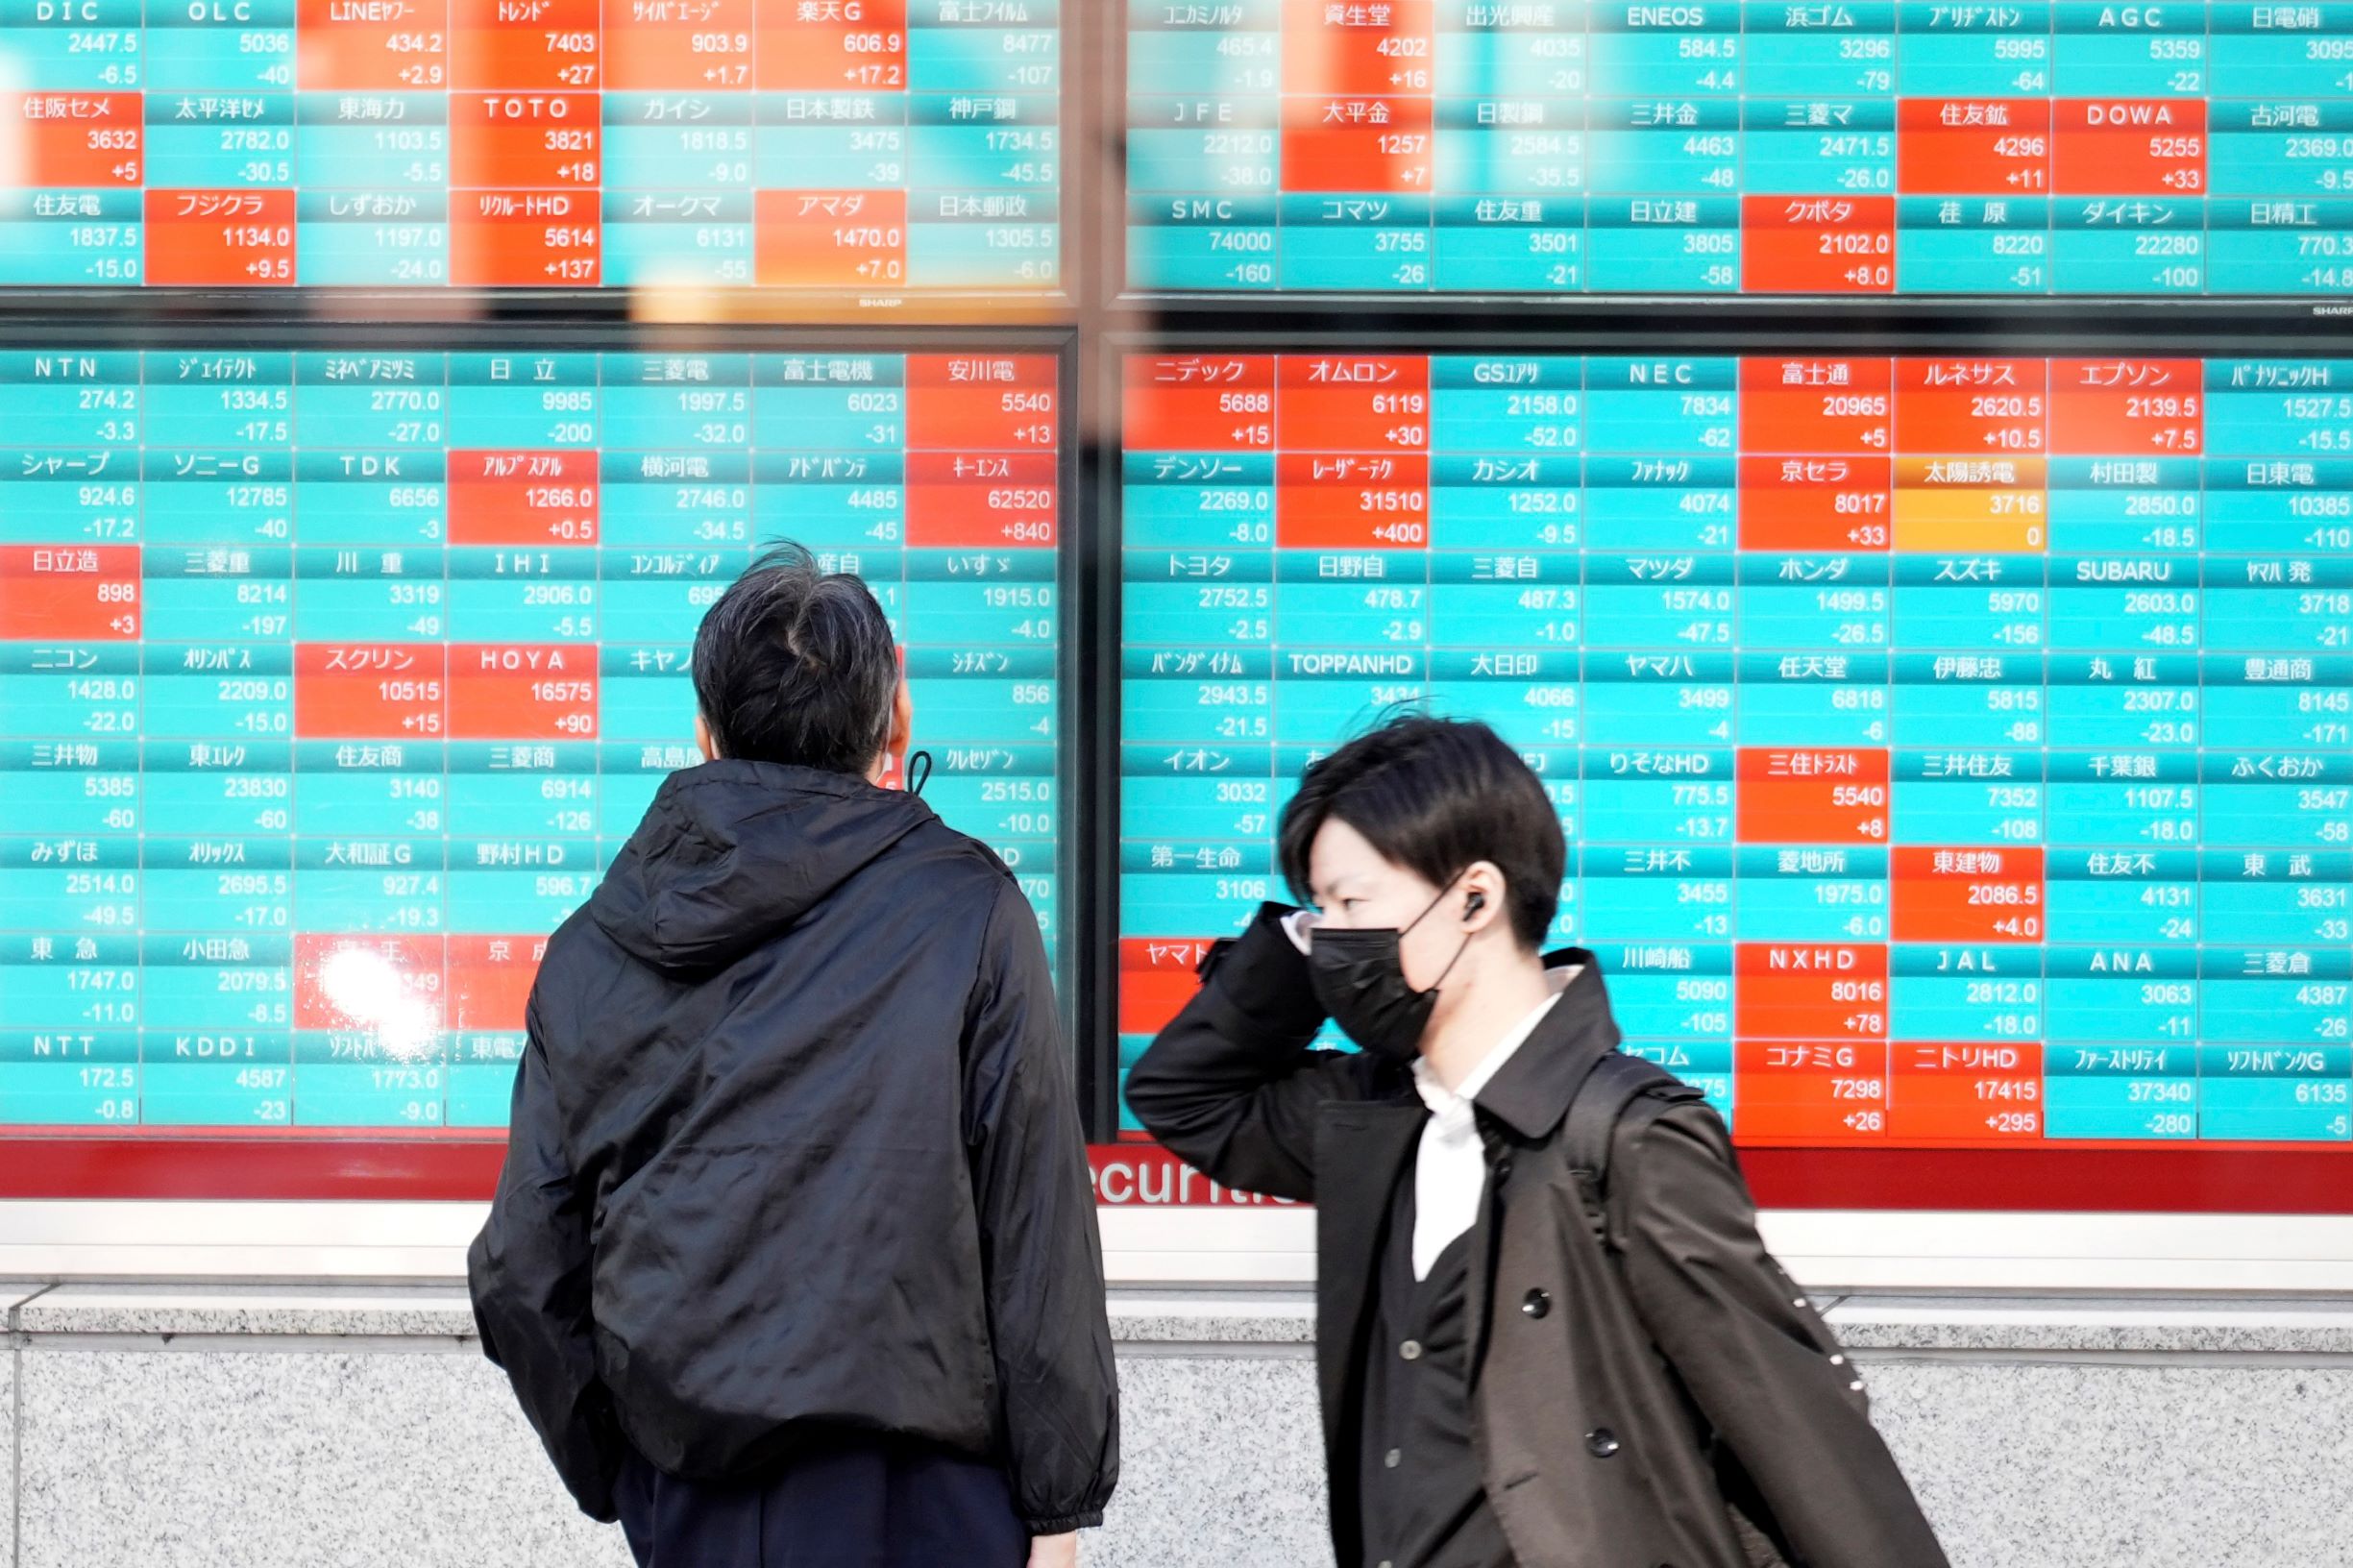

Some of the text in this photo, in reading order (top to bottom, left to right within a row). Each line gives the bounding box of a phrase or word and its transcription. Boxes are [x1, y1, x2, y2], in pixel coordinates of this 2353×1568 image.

[797, 1, 862, 21] 楽天G
[1628, 6, 1703, 27] ENEOS
[844, 33, 902, 53] 606.9
[1679, 37, 1736, 59] 584.5
[845, 64, 900, 86] +17.2
[1696, 70, 1735, 89] -4.4
[22, 97, 111, 118] 住阪セメ
[948, 97, 1017, 119] 神戸鋼
[1323, 101, 1389, 124] 大平金
[1784, 103, 1852, 126] 三菱マ
[1939, 103, 2008, 126] 住友鉱
[87, 130, 137, 150] 3632
[544, 130, 594, 151] 3821
[985, 132, 1052, 152] 1734.5
[1377, 135, 1426, 155] 1257
[1819, 135, 1890, 157] 2471.5
[1993, 136, 2045, 157] 4296
[2149, 137, 2200, 158] 5255
[111, 160, 137, 182] +5
[556, 161, 595, 182] +18
[1000, 163, 1052, 182] -45.5
[1400, 165, 1429, 185] +7
[1836, 167, 1890, 188] -26.0
[2006, 168, 2044, 188] +11
[2161, 169, 2200, 189] +33
[34, 193, 101, 216] 住友電
[178, 194, 263, 216] フジクラ
[1322, 200, 1388, 221] コマツ
[1474, 199, 1541, 222] 住友重
[1630, 199, 1697, 224] 日立建
[1785, 199, 1853, 222] クボタ
[2082, 201, 2173, 224] ダイキン
[70, 226, 138, 247] 1837.5
[222, 227, 290, 247] 1134.0
[1375, 232, 1426, 252] 3755
[1529, 233, 1579, 253] 3501
[1683, 233, 1734, 254] 3805
[1819, 233, 1891, 255] 2102.0
[2135, 234, 2199, 256] 22280
[86, 258, 137, 279] -15.0
[245, 258, 290, 279] +9.5
[1391, 264, 1426, 283] -26
[1546, 264, 1579, 285] -21
[1700, 265, 1734, 285] -58
[1844, 265, 1890, 285] +8.0
[2152, 266, 2199, 286] -100
[859, 299, 902, 307] SHARP
[642, 358, 709, 381] 三菱電
[783, 358, 872, 381] 富士電機
[947, 359, 1016, 381] 安川電
[1156, 360, 1244, 381] ニデック
[1309, 360, 1397, 382] オムロン
[1781, 362, 1849, 385] 富士通
[1924, 363, 2015, 385] ルネサス
[677, 391, 746, 412] 1997.5
[846, 391, 898, 412] 6023
[1001, 393, 1051, 412] 5540
[1219, 393, 1270, 413] 5688
[1372, 394, 1424, 414] 6119
[1822, 396, 1886, 416] 20965
[1971, 396, 2042, 417] 2620.5
[692, 424, 746, 444] -32.0
[865, 424, 896, 445] -31
[1014, 425, 1051, 444] +13
[1231, 425, 1270, 445] +15
[1385, 426, 1424, 446] +30
[1859, 428, 1886, 448] +5
[1982, 429, 2042, 449] +10.5
[22, 452, 111, 476] シャープ
[175, 453, 259, 477] ソニーG
[1156, 456, 1242, 479] デンソー
[1780, 459, 1850, 482] 京セラ
[1924, 460, 2015, 483] 太陽誘電
[79, 486, 135, 506] 924.6
[226, 485, 287, 507] 12785
[988, 489, 1051, 509] 62520
[1198, 491, 1269, 511] 2269.0
[1834, 492, 1888, 514] 8017
[1989, 493, 2042, 515] 3716
[84, 517, 135, 538] -17.2
[255, 518, 288, 539] -40
[1001, 522, 1050, 541] +840
[1229, 521, 1268, 543] -8.0
[1847, 526, 1888, 547] +33
[33, 549, 98, 573] 日立造
[1169, 553, 1232, 576] トヨタ
[1318, 553, 1383, 577] 日野自
[1626, 557, 1693, 579] マツダ
[2076, 560, 2171, 581] SUBARU
[97, 583, 135, 602] 898
[1198, 587, 1268, 608] 2752.5
[1363, 588, 1424, 609] 478.7
[1661, 591, 1730, 611] 1574.0
[2123, 592, 2196, 614] 2603.0
[110, 614, 135, 634] +3
[1228, 619, 1268, 640] -2.5
[1382, 620, 1423, 642] -2.9
[1676, 623, 1730, 643] -47.5
[2142, 624, 2194, 646] -48.5
[31, 649, 98, 670] ニコン
[325, 649, 414, 671] スクリン
[1777, 656, 1847, 678] 任天堂
[1932, 656, 2000, 680] 伊藤忠
[67, 678, 135, 700] 1428.0
[379, 681, 441, 701] 10515
[530, 681, 593, 701] 16575
[1831, 689, 1885, 710] 6818
[1987, 690, 2040, 710] 5815
[83, 711, 135, 732] -22.0
[402, 713, 441, 733] +15
[554, 714, 593, 734] +90
[1862, 721, 1884, 741] -6
[2004, 722, 2039, 742] -88
[334, 745, 402, 768] 住友商
[488, 746, 554, 769] 三菱商
[1164, 748, 1231, 772] イオン
[1609, 752, 1710, 774] りそなHD
[390, 777, 440, 799] 3140
[541, 779, 592, 799] 6914
[1215, 782, 1266, 803] 3032
[1671, 784, 1729, 806] 775.5
[405, 810, 440, 831] -38
[547, 810, 592, 831] -126
[1233, 814, 1267, 834] -57
[1675, 816, 1730, 838] -13.7
[31, 840, 97, 863] みずほ
[1931, 849, 2002, 874] 東建物
[2086, 852, 2155, 875] 住友不
[65, 873, 135, 894] 2514.0
[1967, 885, 2040, 905] 2086.5
[2140, 886, 2192, 906] 4131
[83, 905, 135, 925] -49.5
[1992, 917, 2039, 937] +4.0
[2159, 918, 2193, 939] -24
[2243, 951, 2311, 975] 三菱倉
[2295, 985, 2351, 1005] 4387
[2314, 1017, 2348, 1038] -26
[1767, 1045, 1854, 1067] コナミG
[1915, 1045, 2018, 1068] ニトリHD
[235, 1067, 286, 1089] 4587
[1830, 1078, 1882, 1099] 7298
[1974, 1080, 2037, 1100] 17415
[253, 1100, 286, 1120] -23
[1842, 1112, 1881, 1131] +26
[1985, 1113, 2036, 1132] +295
